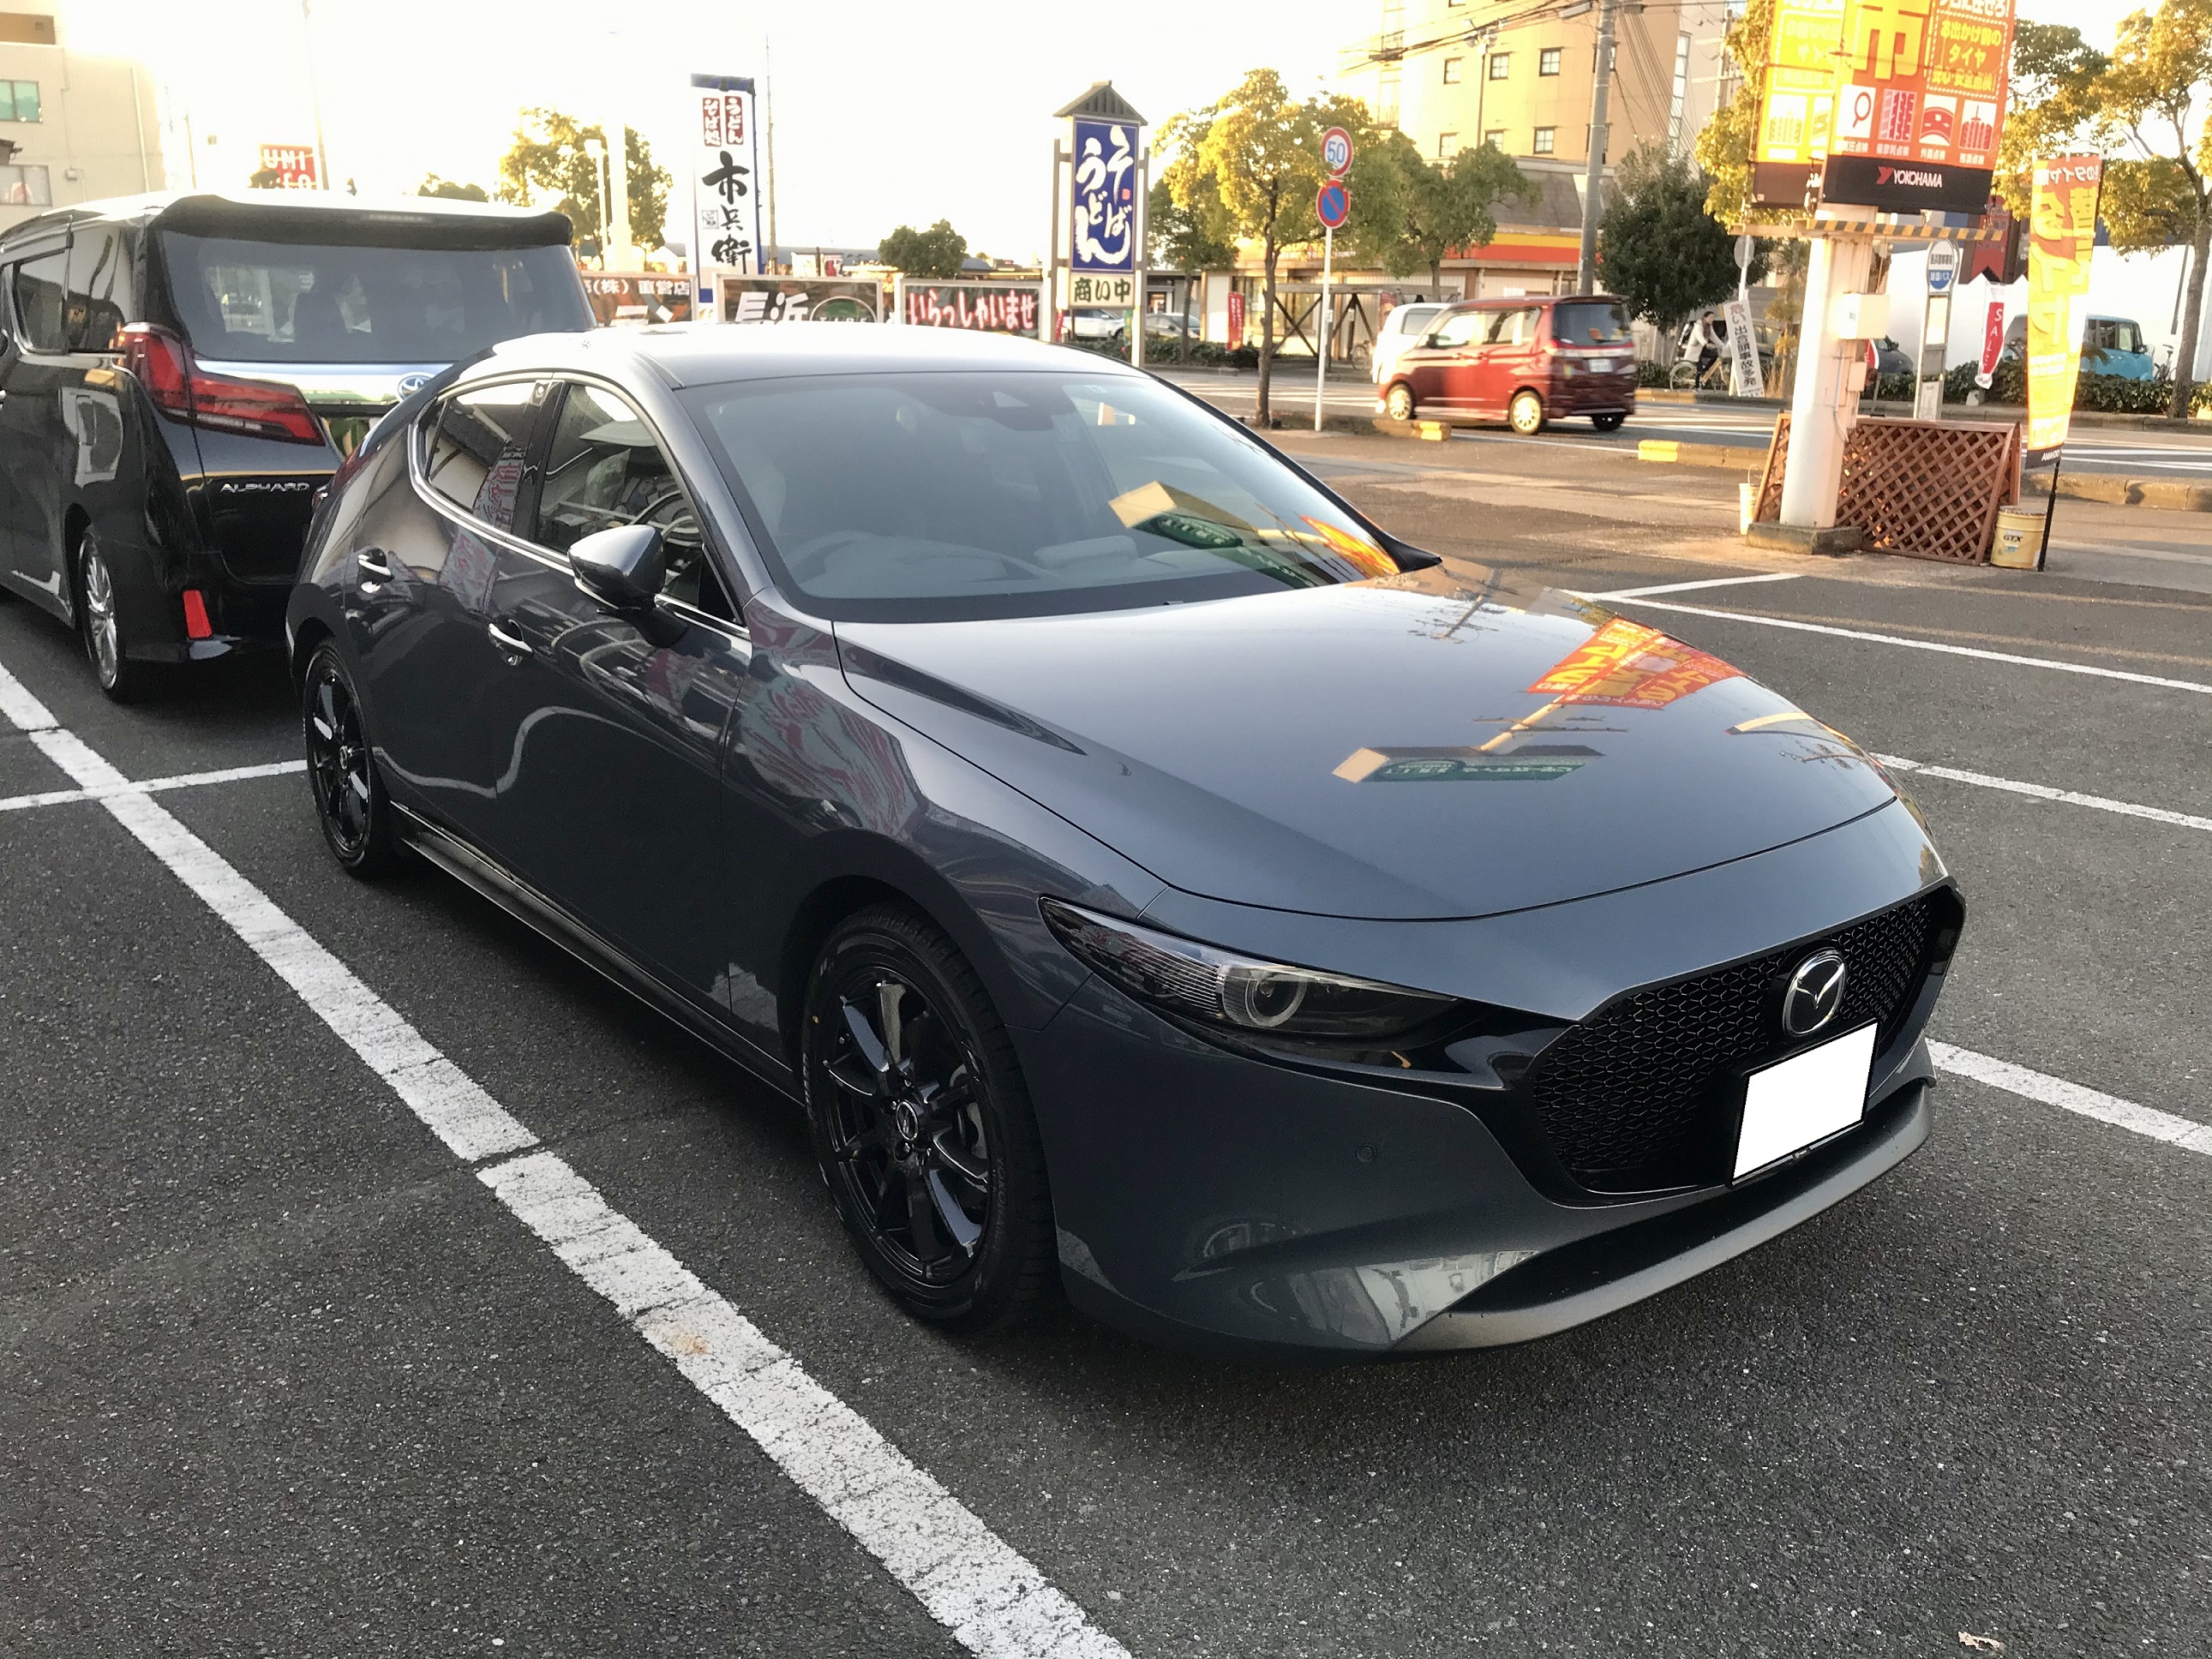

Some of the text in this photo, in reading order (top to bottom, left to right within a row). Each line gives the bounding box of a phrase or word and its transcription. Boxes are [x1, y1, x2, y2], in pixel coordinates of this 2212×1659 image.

[1949, 43, 1987, 69] タイヤ
[726, 98, 743, 144] うどん
[1328, 141, 1346, 163] 50
[1894, 169, 1943, 188] YOKOHAMA
[701, 151, 752, 274] 市兵衛
[1076, 137, 1131, 264] うどん
[638, 279, 690, 296] 直営店
[1074, 277, 1131, 303] 商い中
[909, 289, 1035, 330] いらっしゃいませ
[220, 482, 310, 494] ALPHARD
